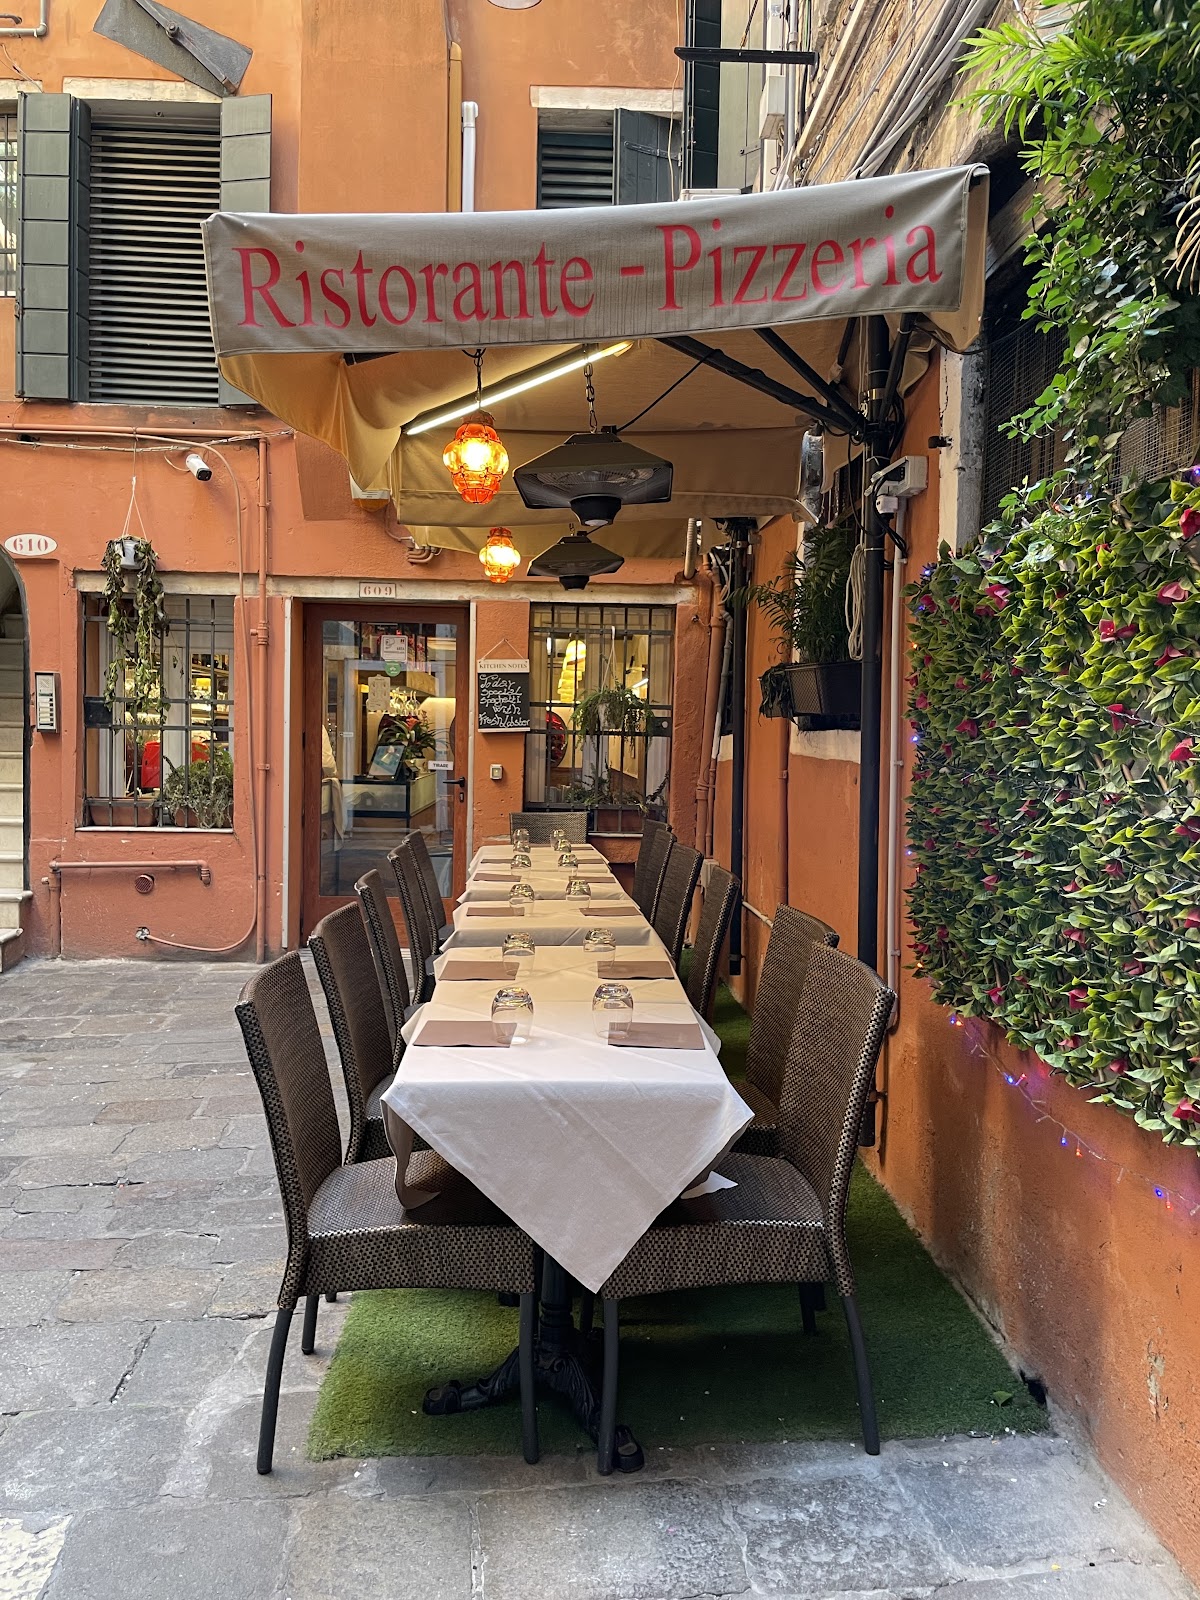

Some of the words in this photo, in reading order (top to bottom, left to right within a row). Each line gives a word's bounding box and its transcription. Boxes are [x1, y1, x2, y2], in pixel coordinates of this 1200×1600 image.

[232, 240, 595, 330] Ristorante
[656, 205, 943, 312] Pizzeria
[13, 538, 48, 551] 610
[364, 586, 392, 596] 609
[479, 674, 516, 690] Today
